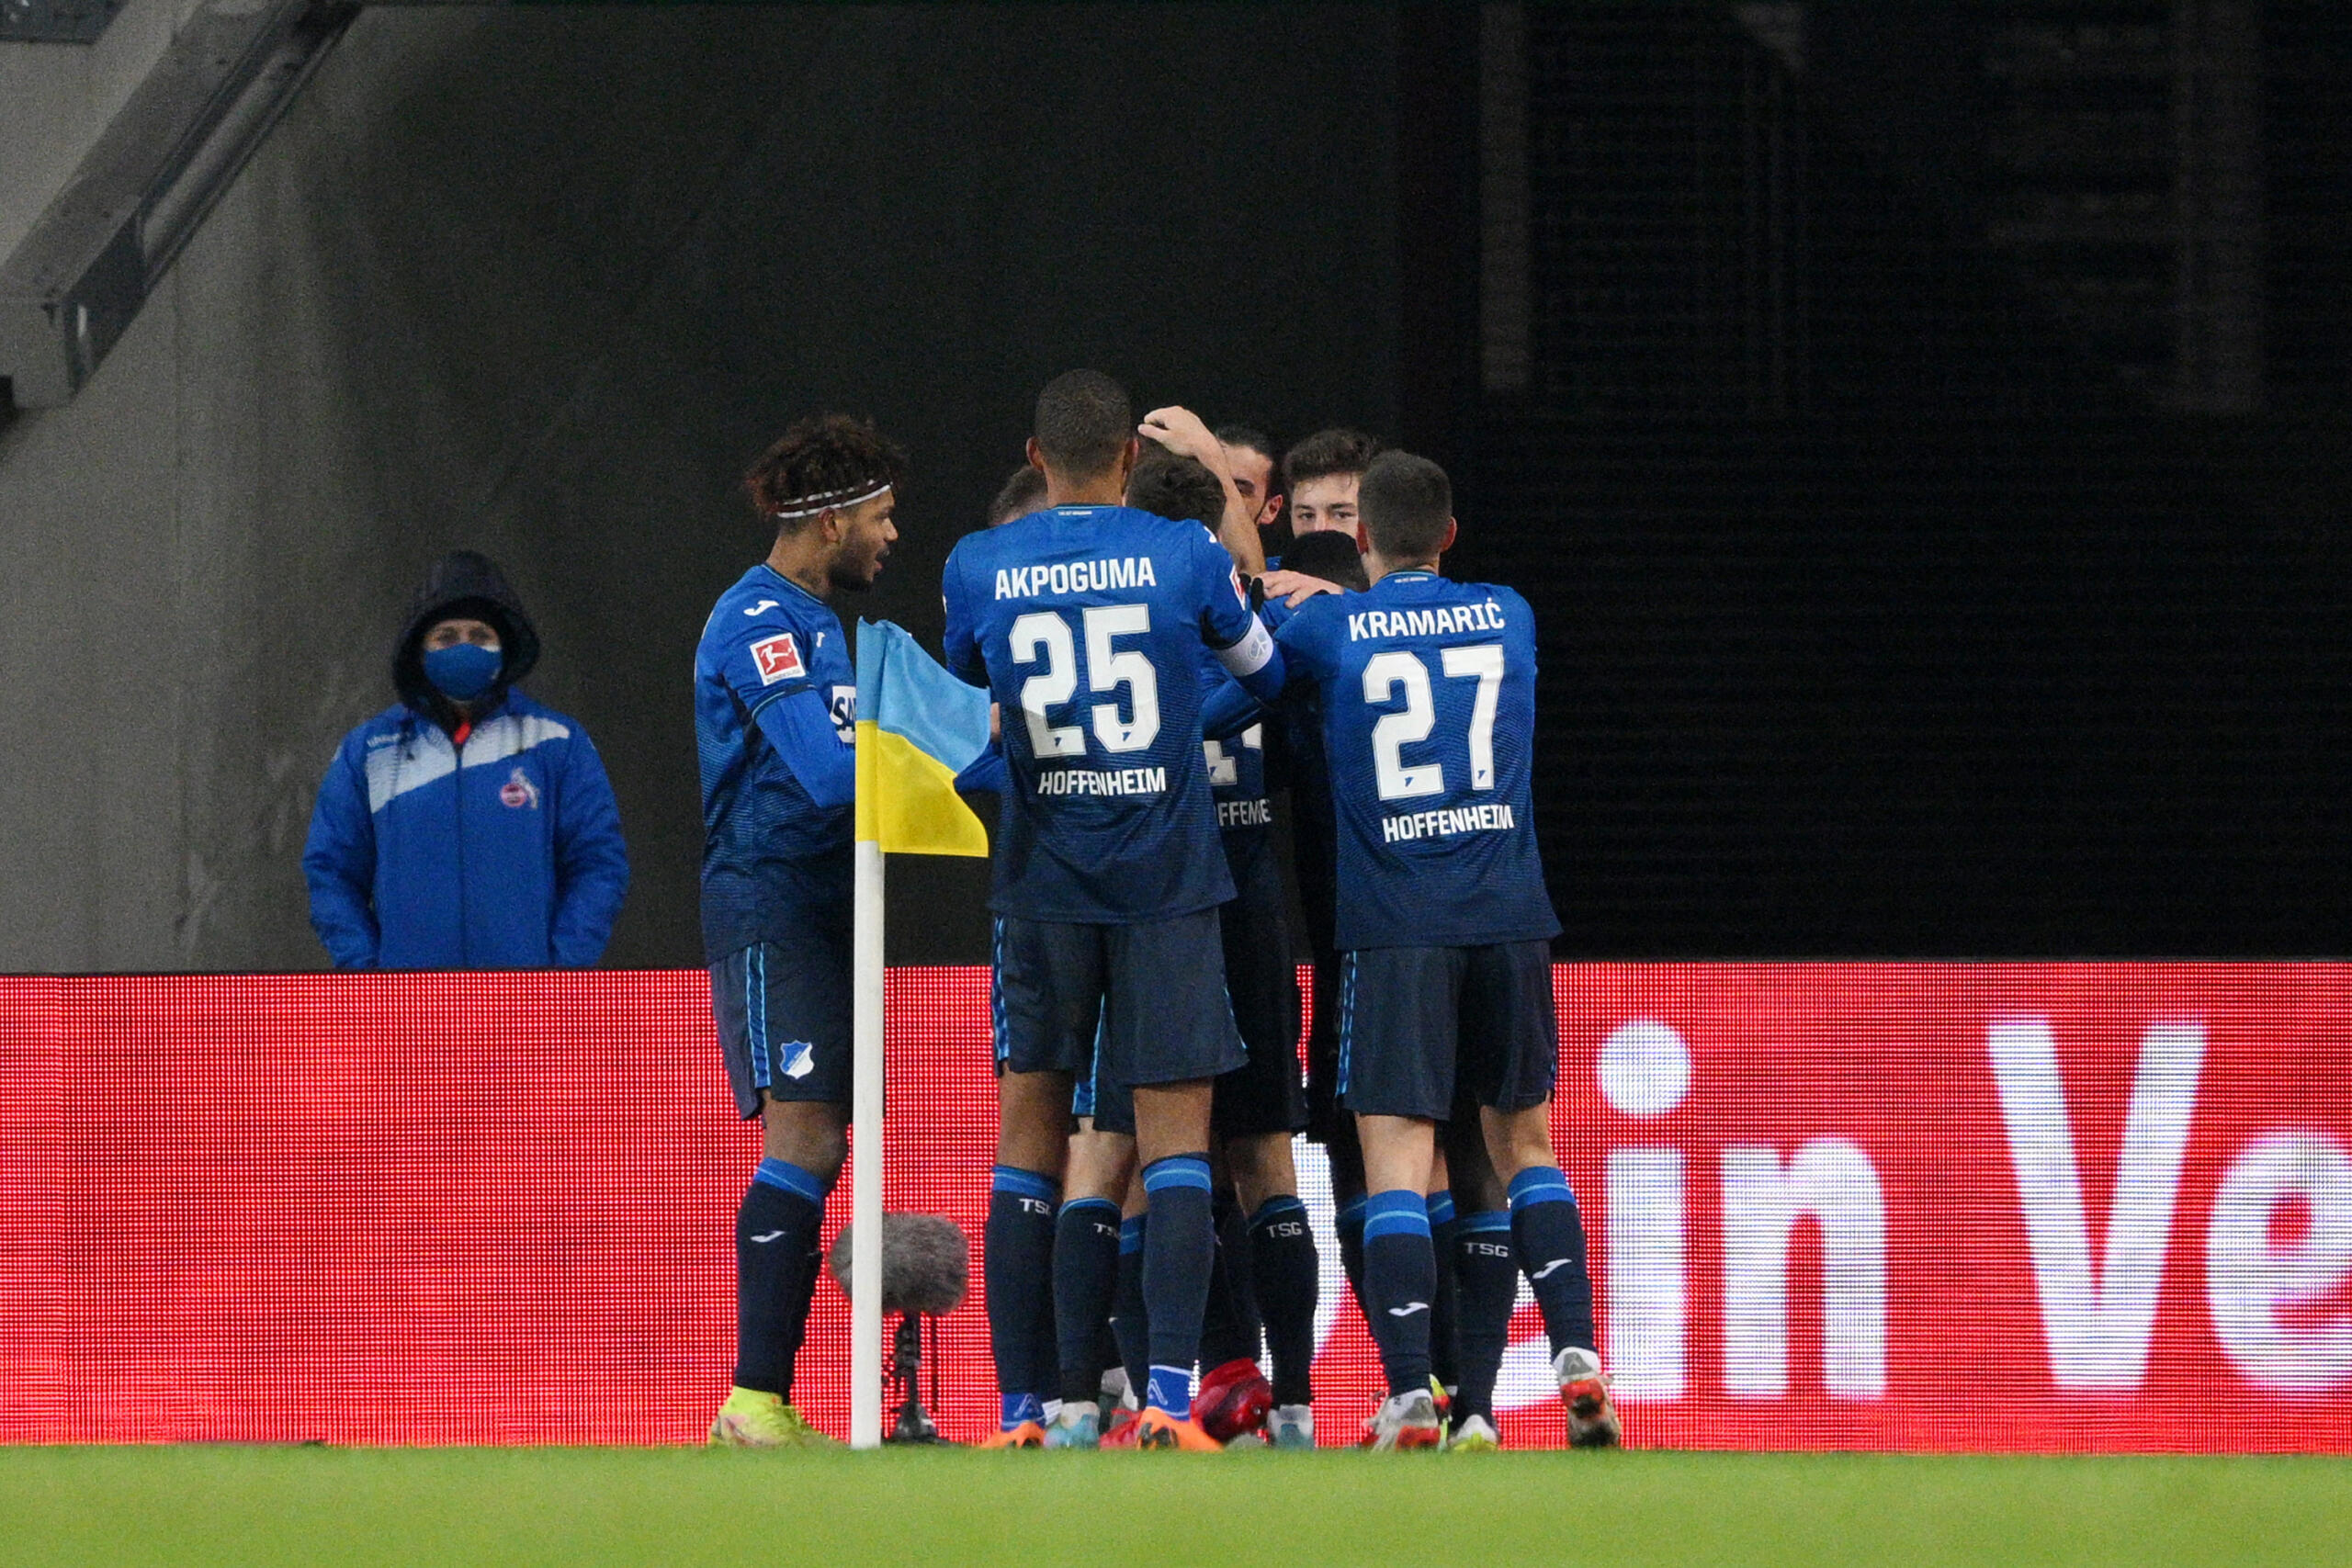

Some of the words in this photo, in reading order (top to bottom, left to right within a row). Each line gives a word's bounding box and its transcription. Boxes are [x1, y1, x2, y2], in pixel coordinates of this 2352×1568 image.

[995, 557, 1157, 601] AKPOGUMA
[1349, 597, 1506, 642] KRAMARIĆ
[1008, 603, 1161, 759] 25
[1363, 644, 1504, 801] 27
[1037, 767, 1167, 796] HOFFENHEIM
[1382, 805, 1515, 843] HOFFENHEIM
[1093, 1223, 1121, 1241] TS
[1266, 1222, 1302, 1238] TSG
[1463, 1242, 1509, 1258] TSG
